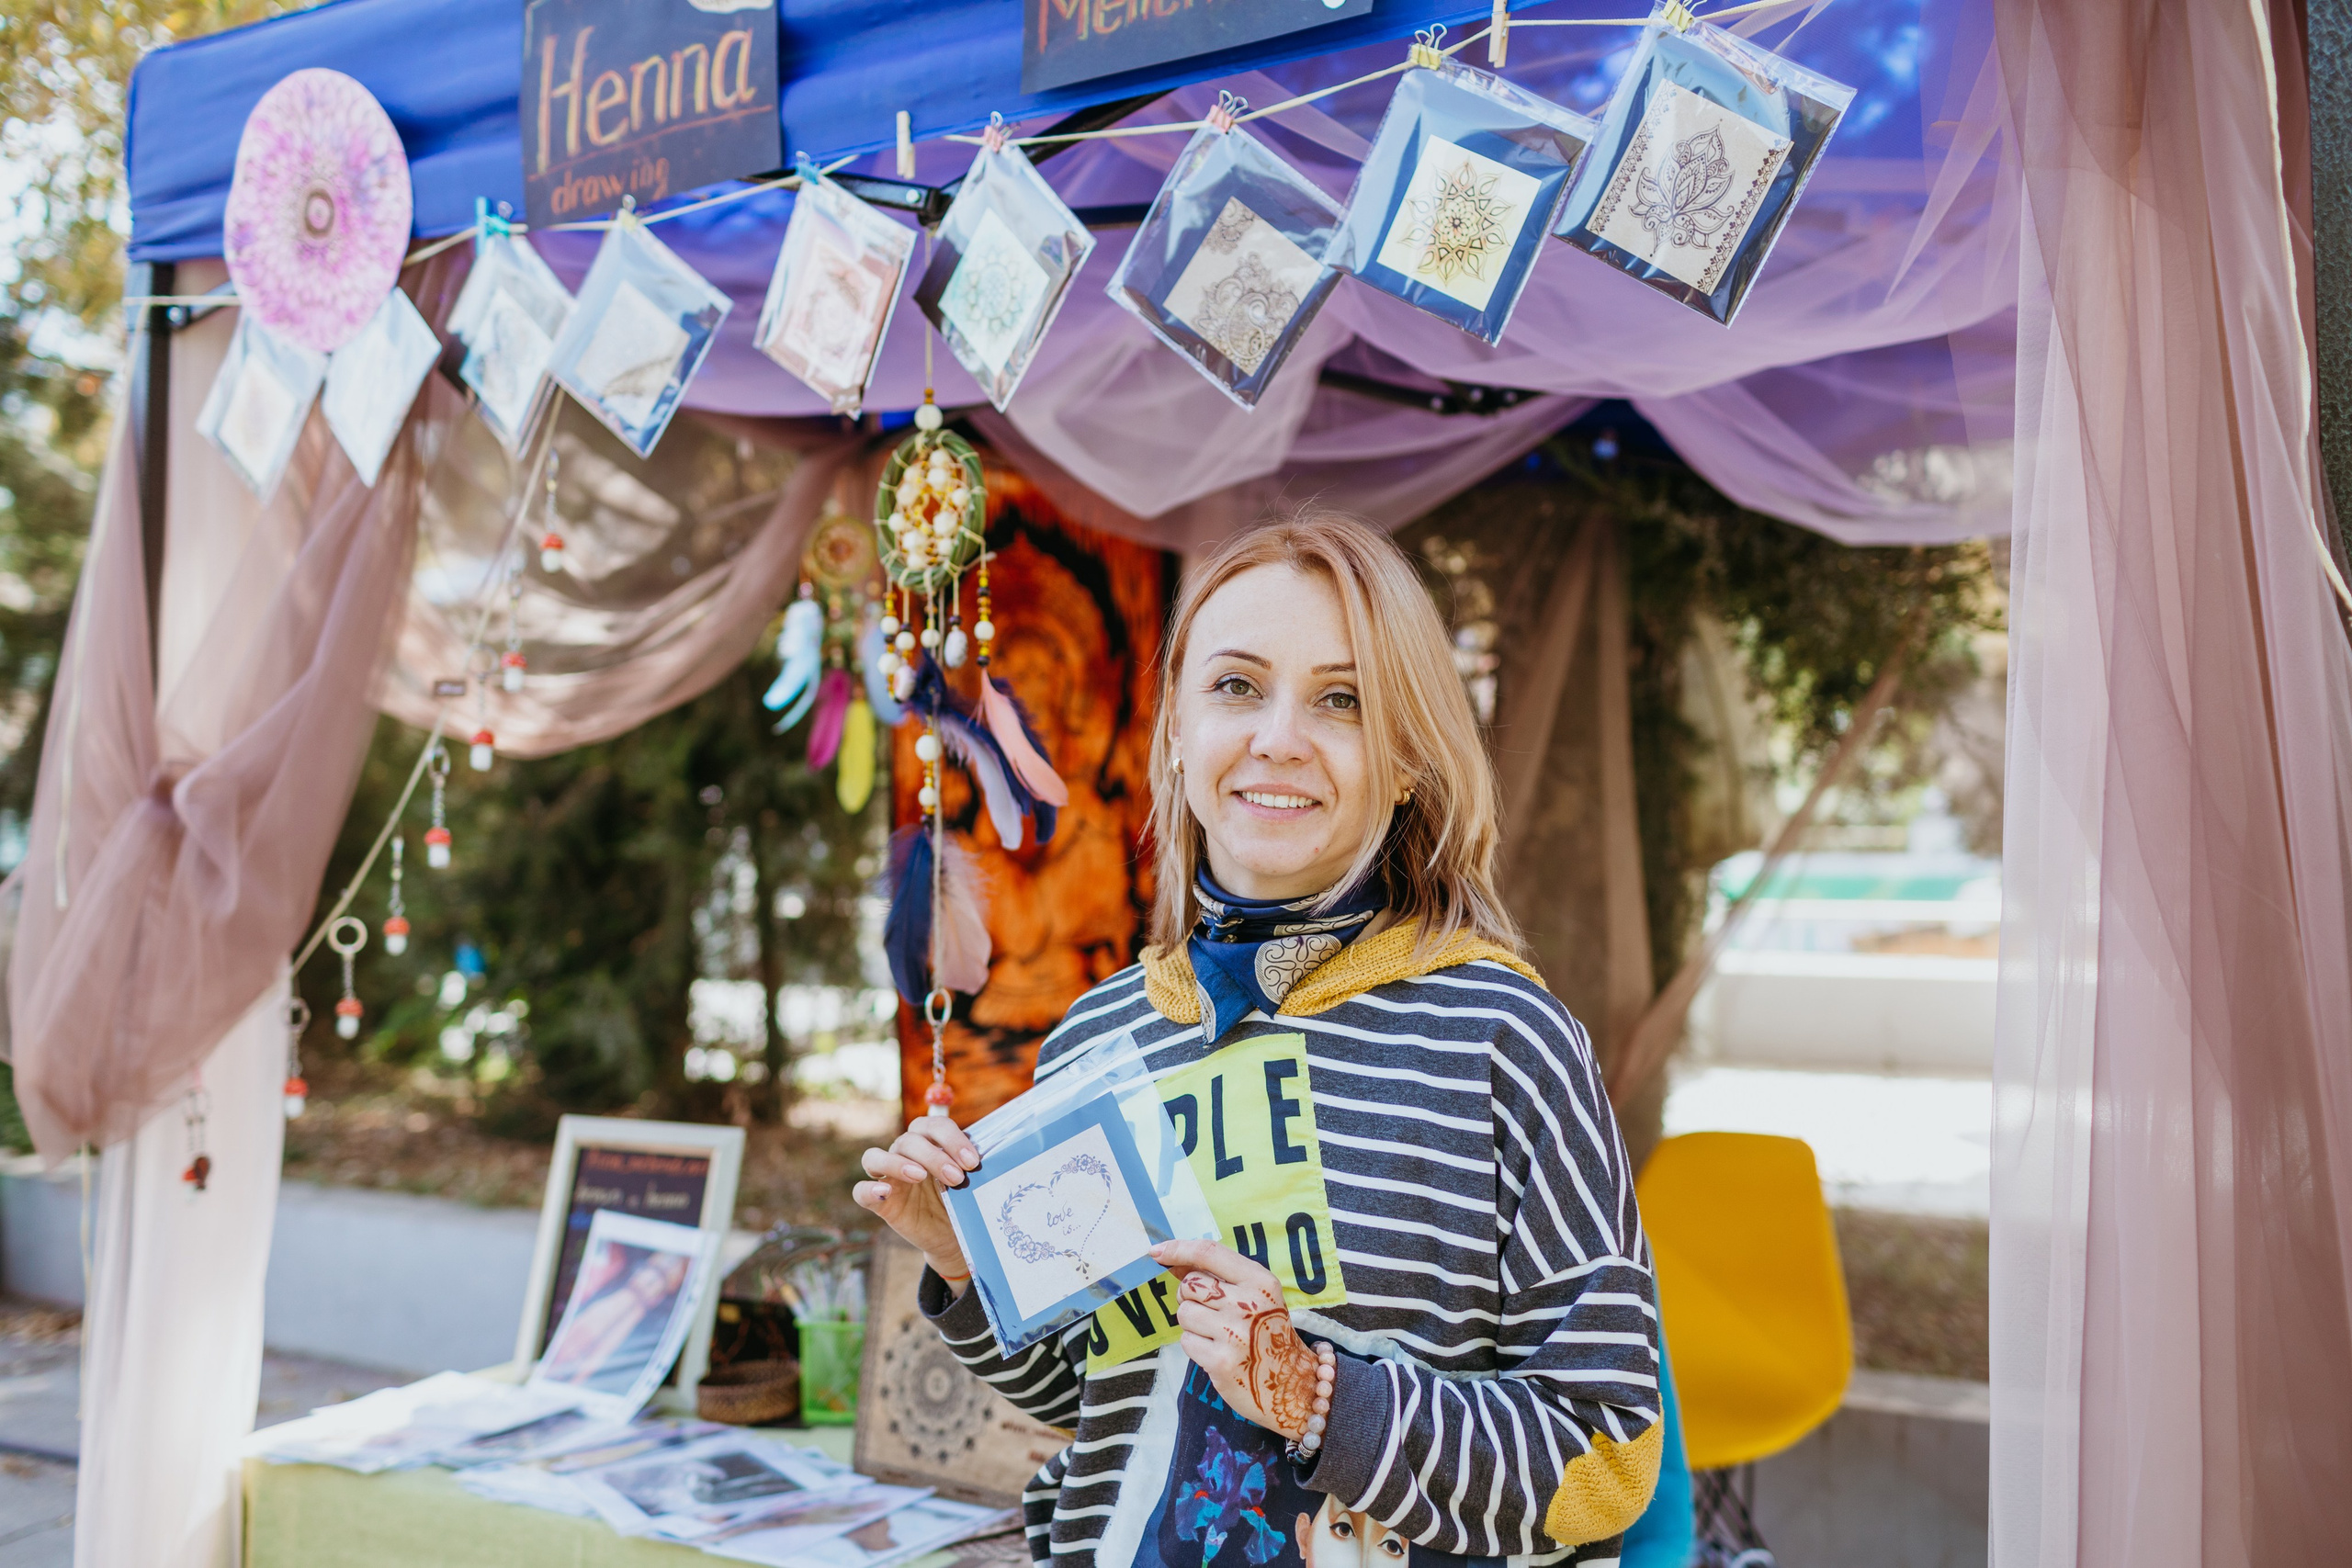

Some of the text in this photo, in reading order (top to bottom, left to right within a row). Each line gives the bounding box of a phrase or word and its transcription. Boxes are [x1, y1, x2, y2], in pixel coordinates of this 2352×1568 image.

[537, 26, 758, 176] Henna
[551, 156, 671, 216] drawing
[1125, 1057, 1308, 1199] PLE
[1046, 1200, 1074, 1228] love
[1202, 1212, 1328, 1295] HO
